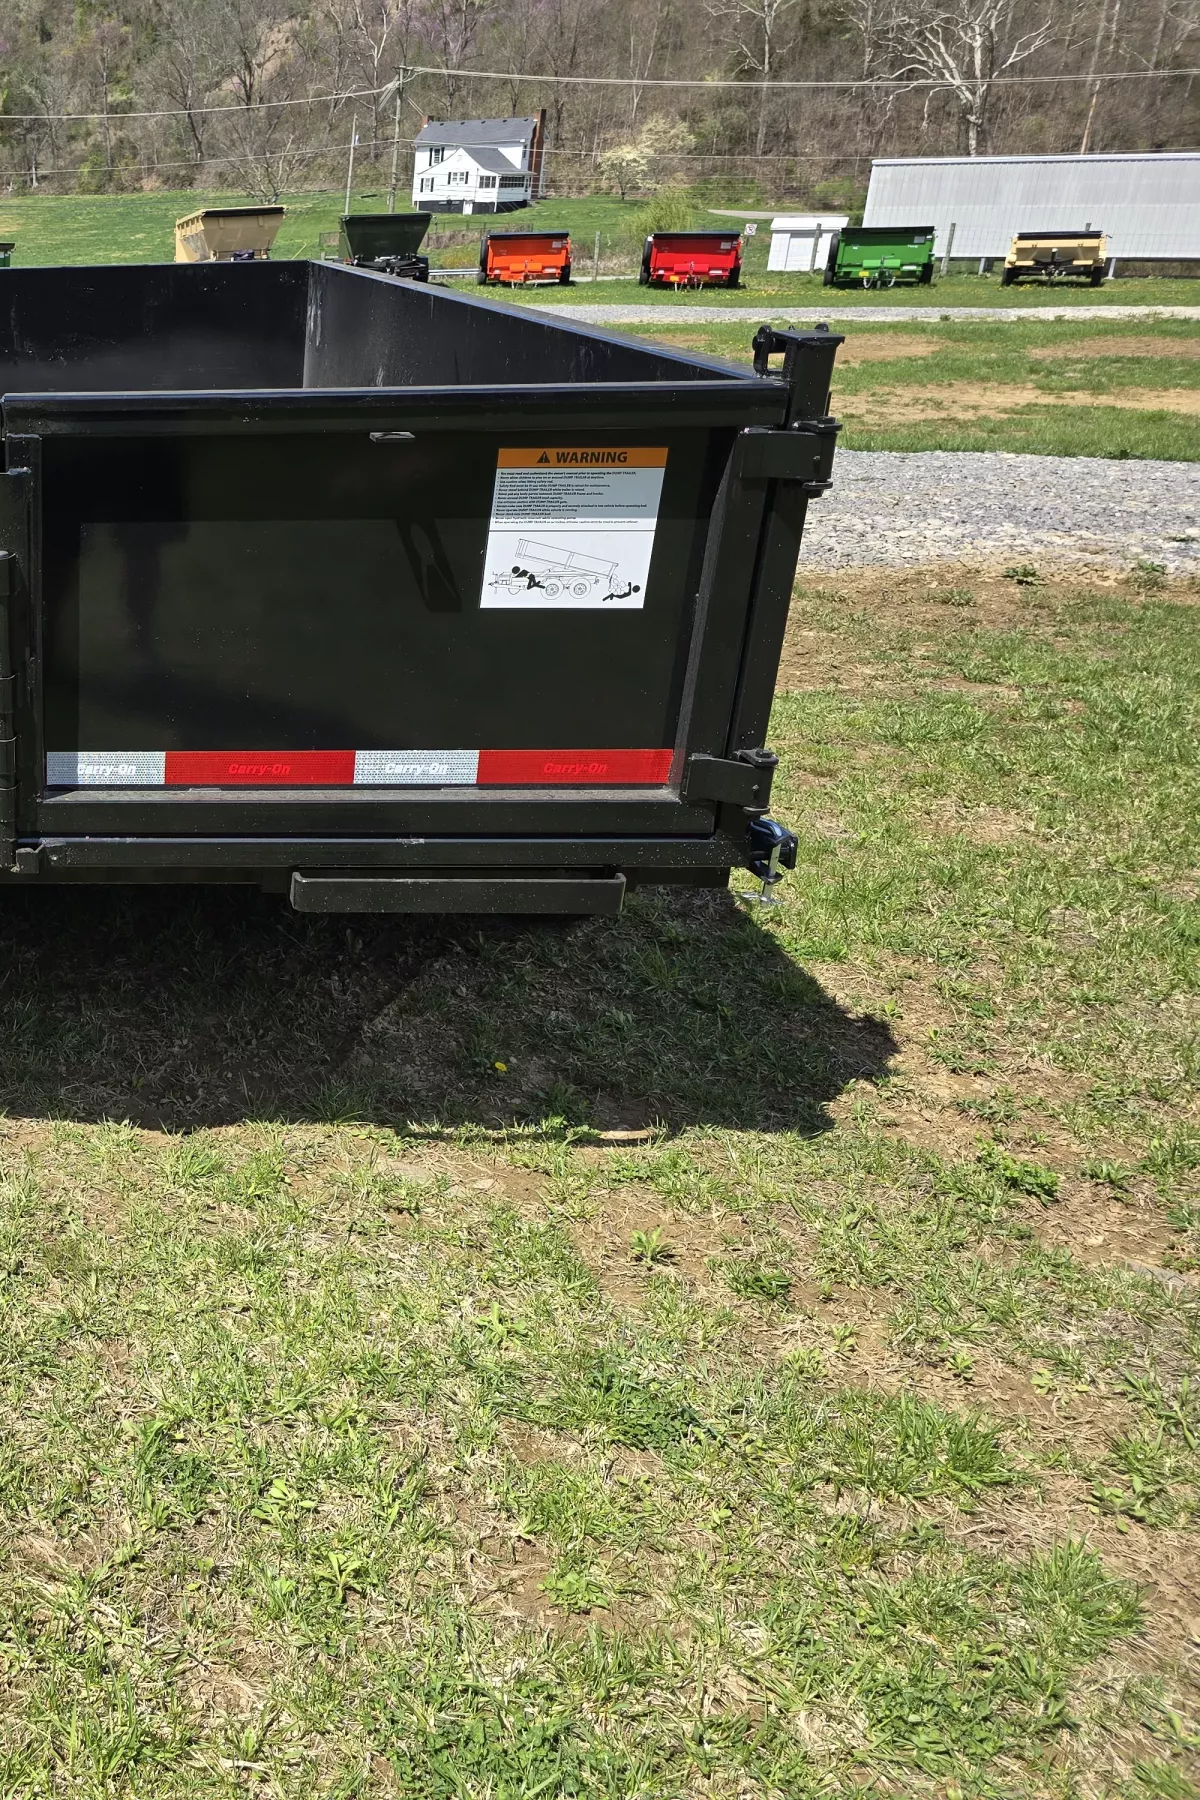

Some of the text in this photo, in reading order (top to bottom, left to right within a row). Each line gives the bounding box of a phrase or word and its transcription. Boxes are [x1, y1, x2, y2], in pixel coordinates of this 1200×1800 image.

[556, 452, 627, 463] WARNING
[228, 764, 290, 776] Carry-On
[385, 764, 446, 775] Carry-On
[544, 763, 607, 774] Carry-On
